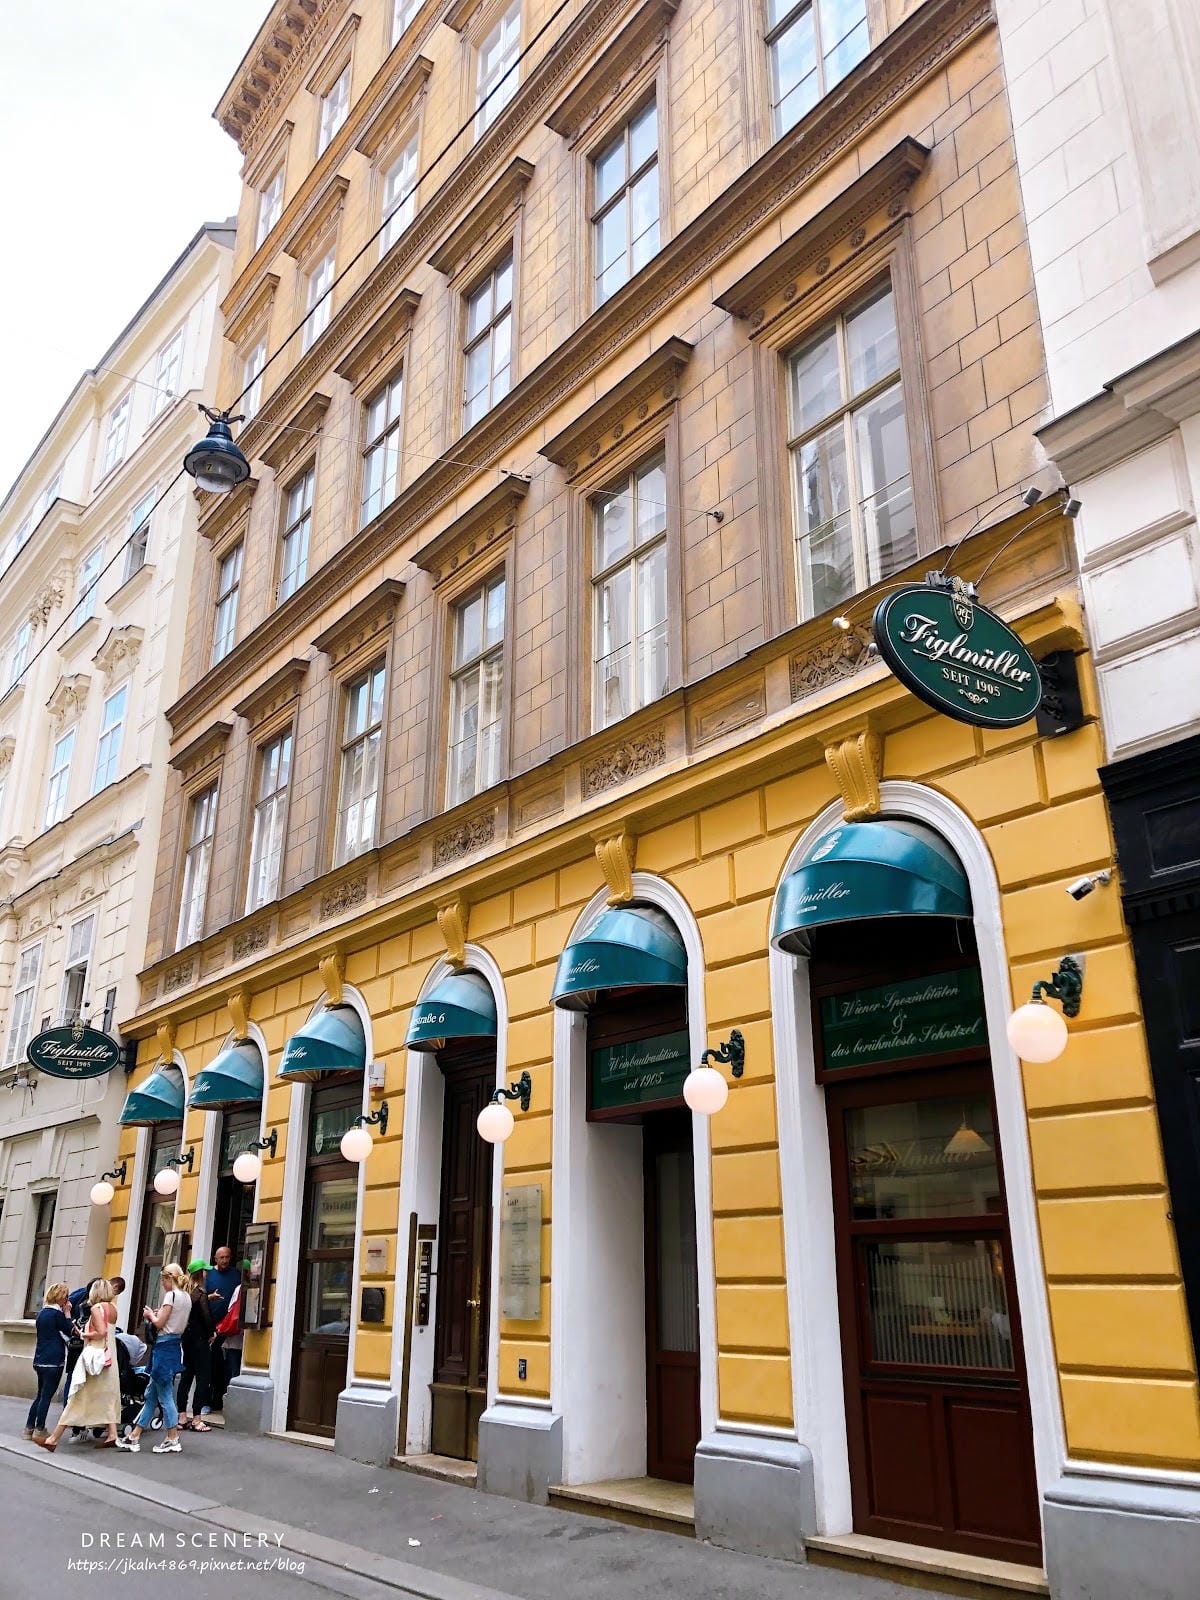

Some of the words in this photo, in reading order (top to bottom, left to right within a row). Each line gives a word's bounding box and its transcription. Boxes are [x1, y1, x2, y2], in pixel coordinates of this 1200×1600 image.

[900, 613, 1031, 683] Figlmüller
[942, 667, 970, 687] SEIT
[975, 679, 1001, 697] 1905
[841, 1002, 881, 1018] Wiener
[882, 984, 960, 1012] Spezialitäten
[438, 1012, 446, 1024] 6
[892, 1010, 908, 1035] &
[36, 1040, 114, 1060] Figlmüller
[831, 1041, 851, 1059] das
[852, 1033, 917, 1058] berühmteste
[918, 1017, 981, 1043] Schnitzel
[57, 1059, 74, 1067] SEIT
[609, 1048, 679, 1072] Weinbautradition
[623, 1077, 639, 1091] seit
[639, 1071, 665, 1088] 1905
